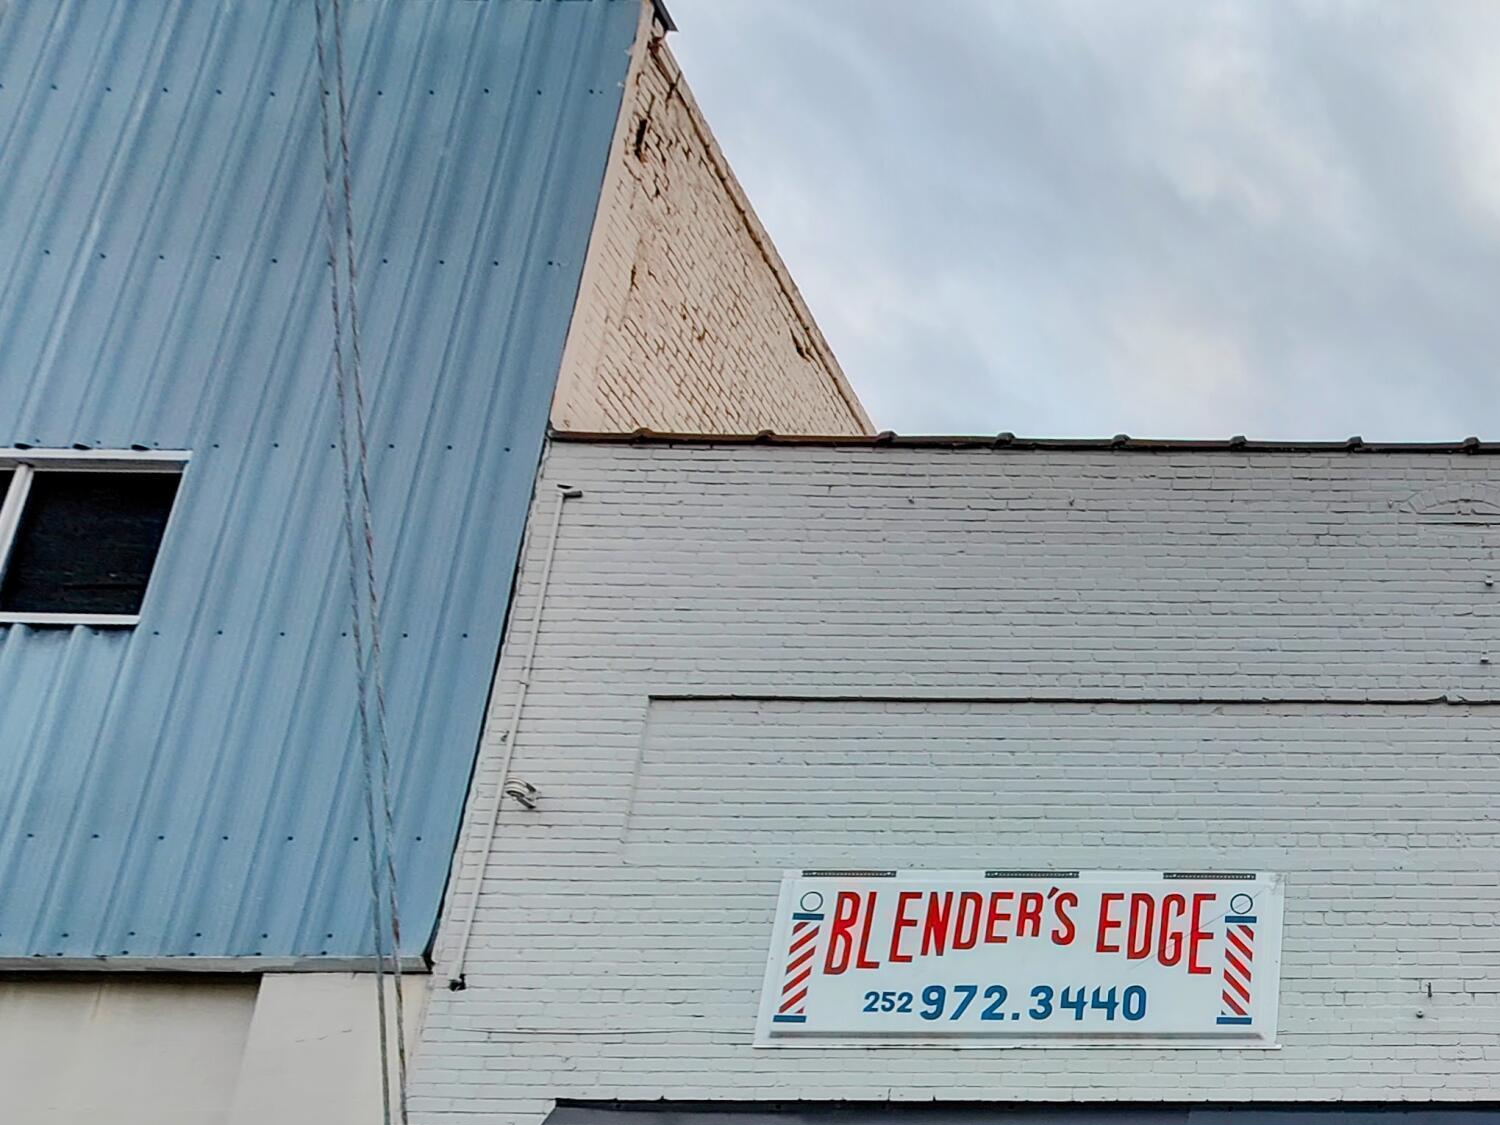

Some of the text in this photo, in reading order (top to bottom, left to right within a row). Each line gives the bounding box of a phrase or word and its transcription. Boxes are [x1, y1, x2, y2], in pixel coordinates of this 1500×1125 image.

[823, 886, 1216, 976] BLENDER'S EDGE
[862, 984, 1148, 1022] 252 972.3440
